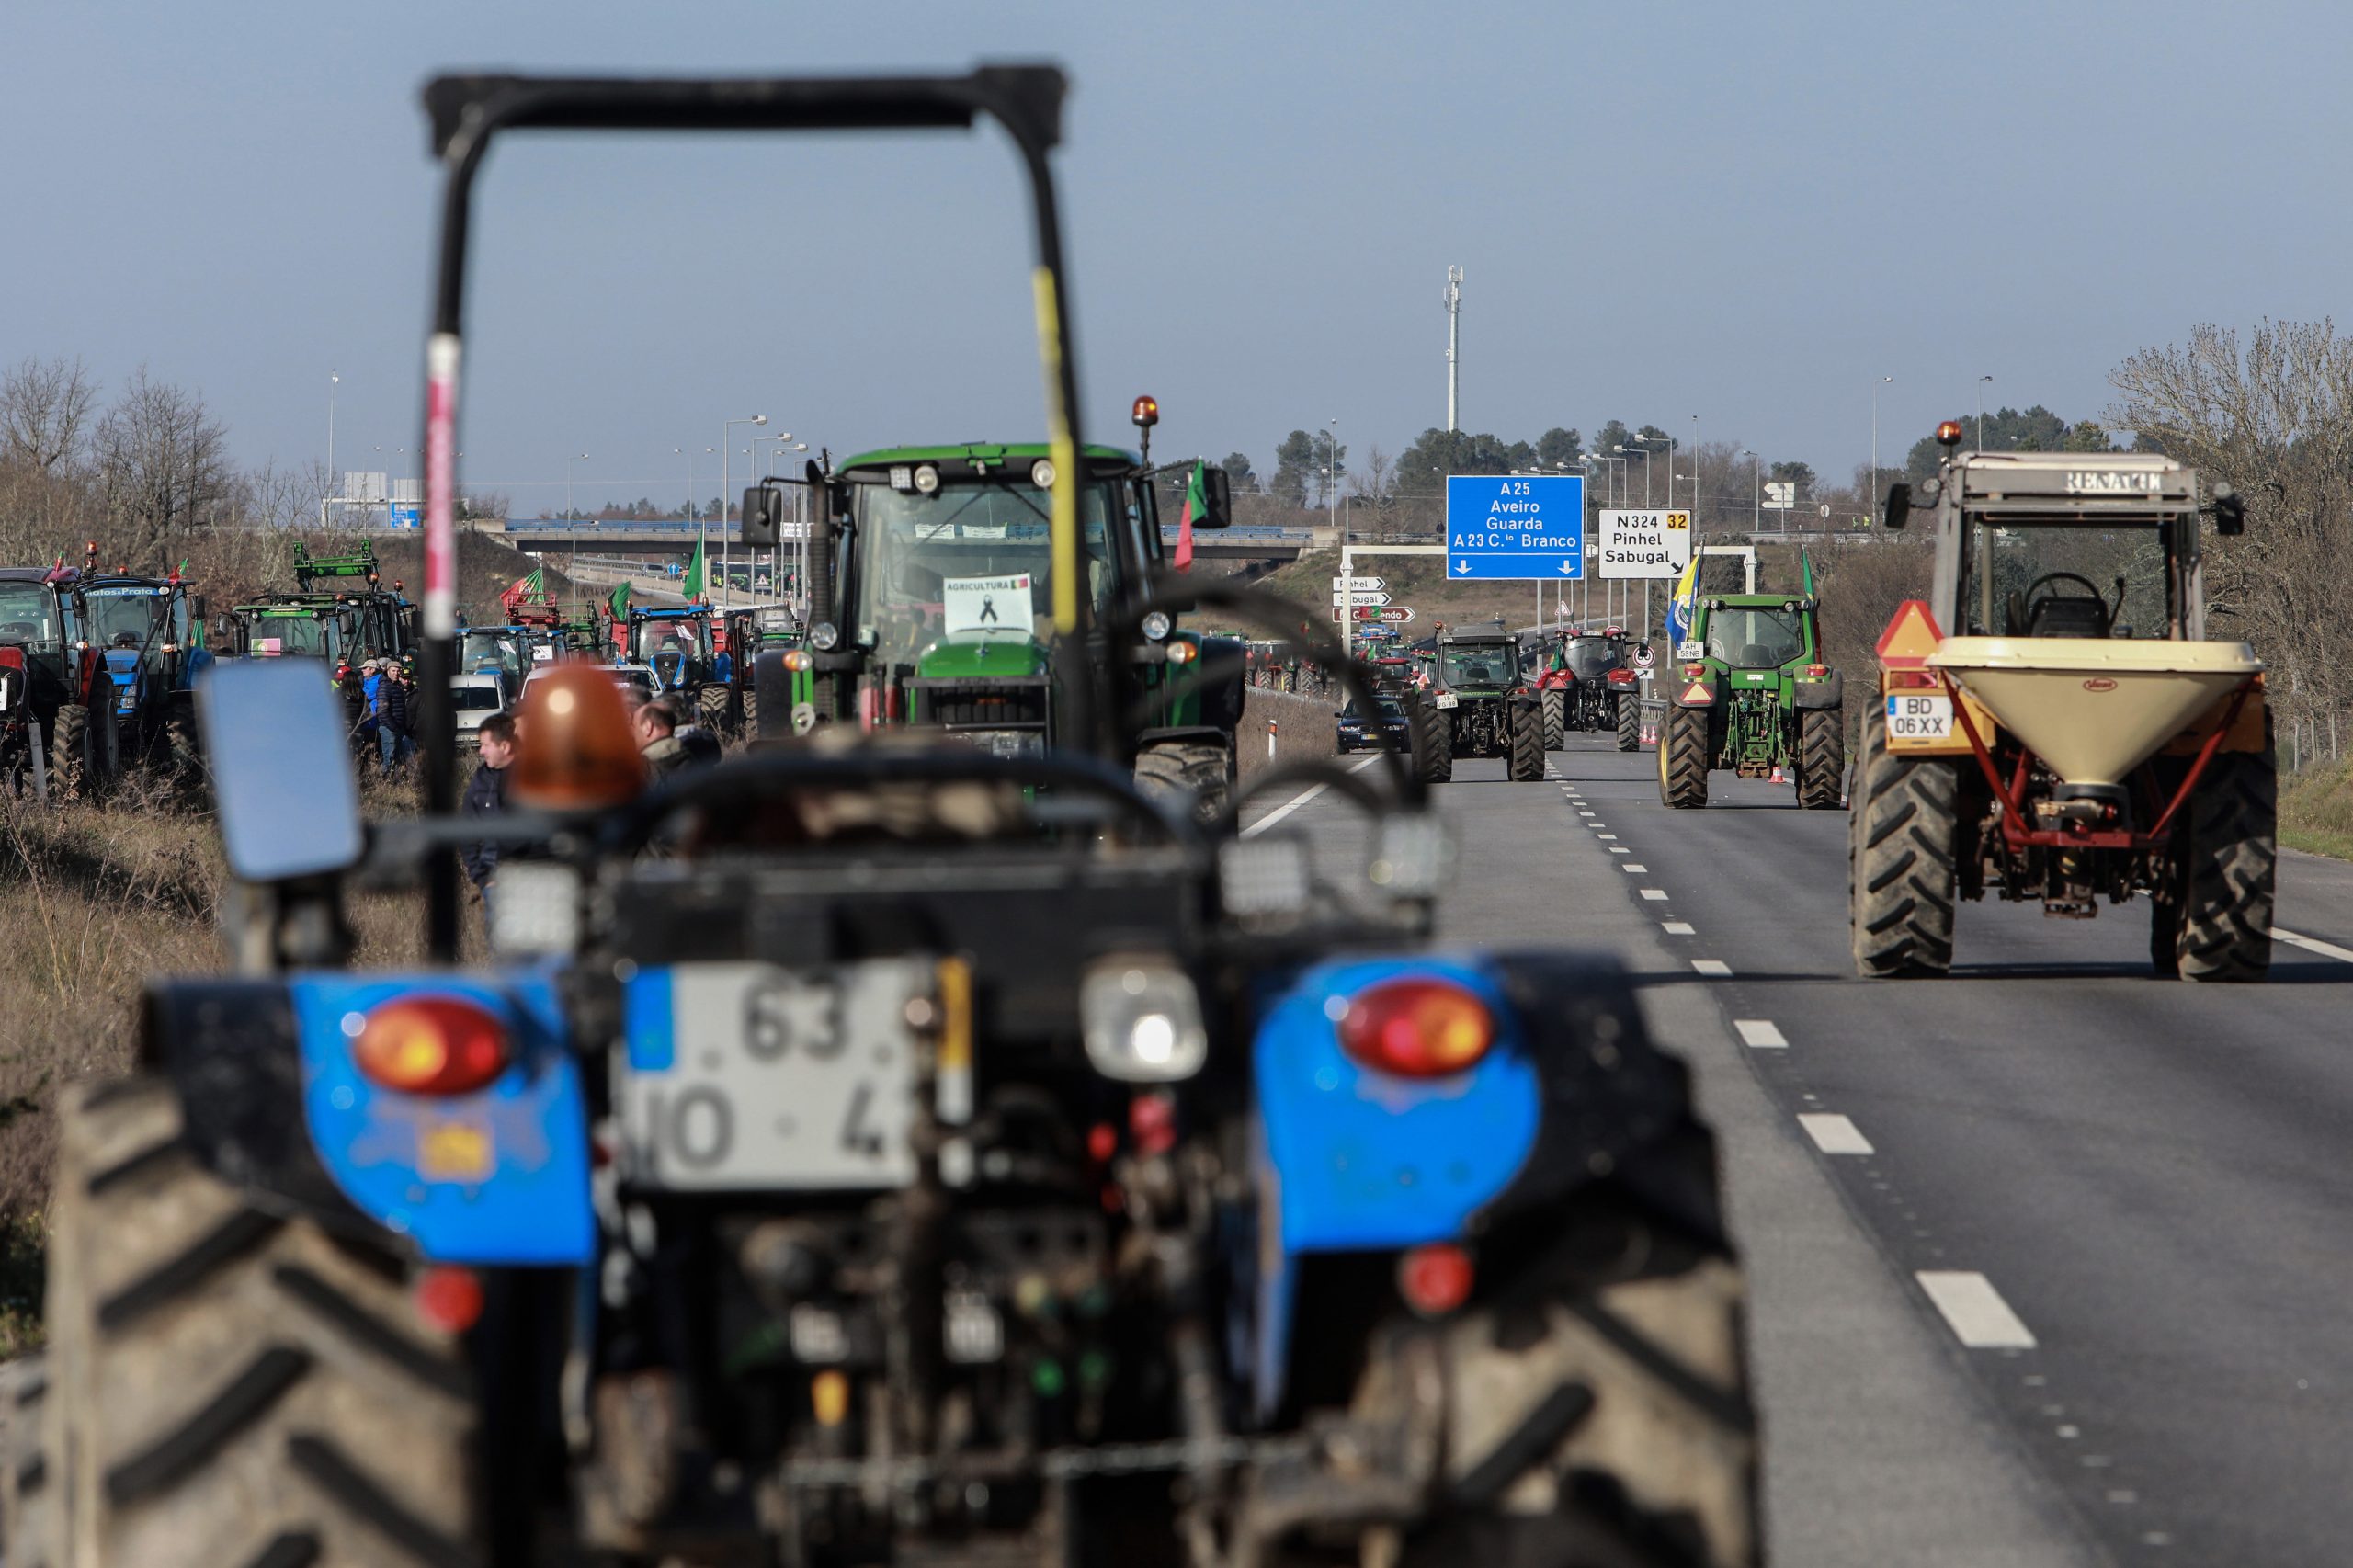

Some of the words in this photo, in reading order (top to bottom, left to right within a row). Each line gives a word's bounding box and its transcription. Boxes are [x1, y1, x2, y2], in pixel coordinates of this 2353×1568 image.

[1491, 500, 1540, 513] Aveiro
[1486, 517, 1543, 530] Guarda
[1667, 515, 1686, 528] 32
[1521, 534, 1576, 547] Branco
[1613, 533, 1663, 545] Pinhel
[1605, 551, 1670, 565] Sabugal
[947, 581, 1009, 591] AGRICULTURA
[1339, 596, 1378, 604] Sbugal
[1907, 699, 1933, 715] BD
[739, 969, 853, 1063] 63
